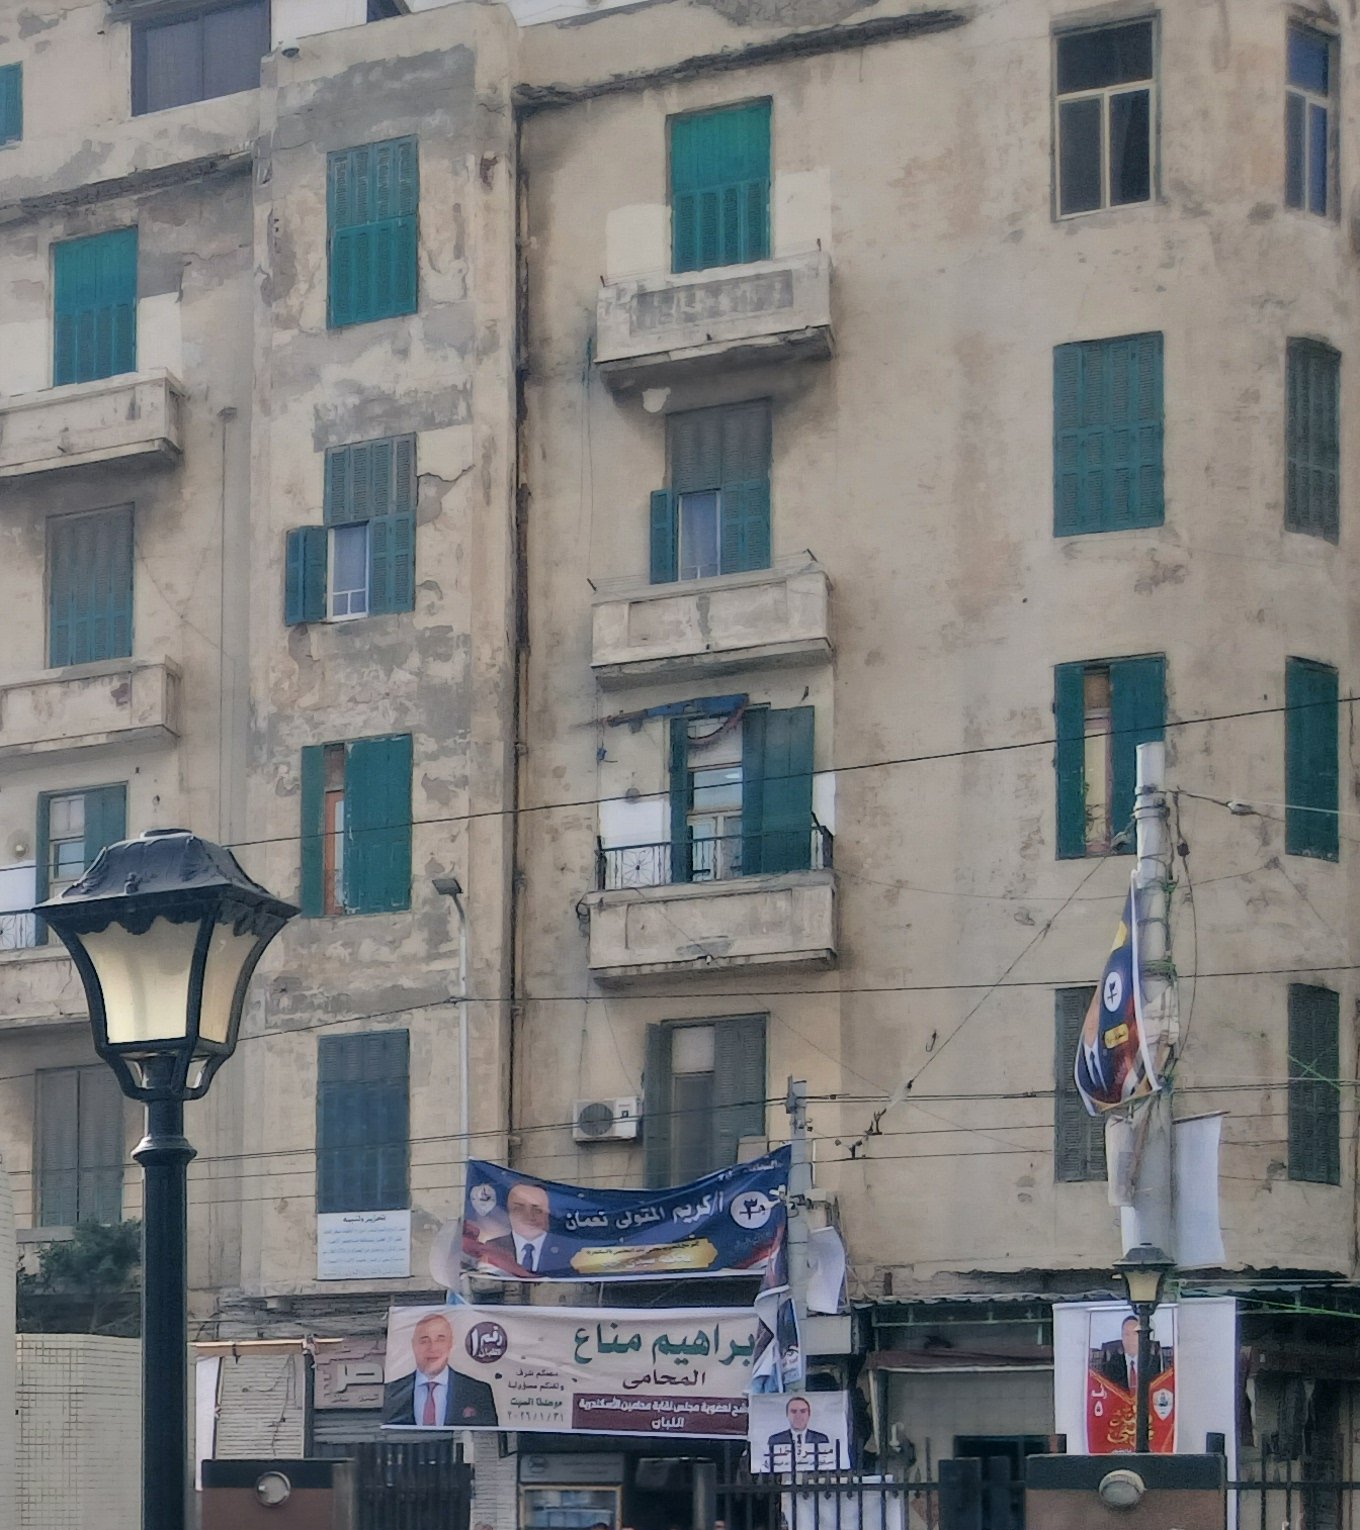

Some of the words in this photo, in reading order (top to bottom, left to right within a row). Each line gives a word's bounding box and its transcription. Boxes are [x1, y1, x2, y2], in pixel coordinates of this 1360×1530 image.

[573, 1321, 643, 1364] مناع
[652, 1321, 756, 1366] براهيم
[651, 1416, 685, 1430] اللبان
